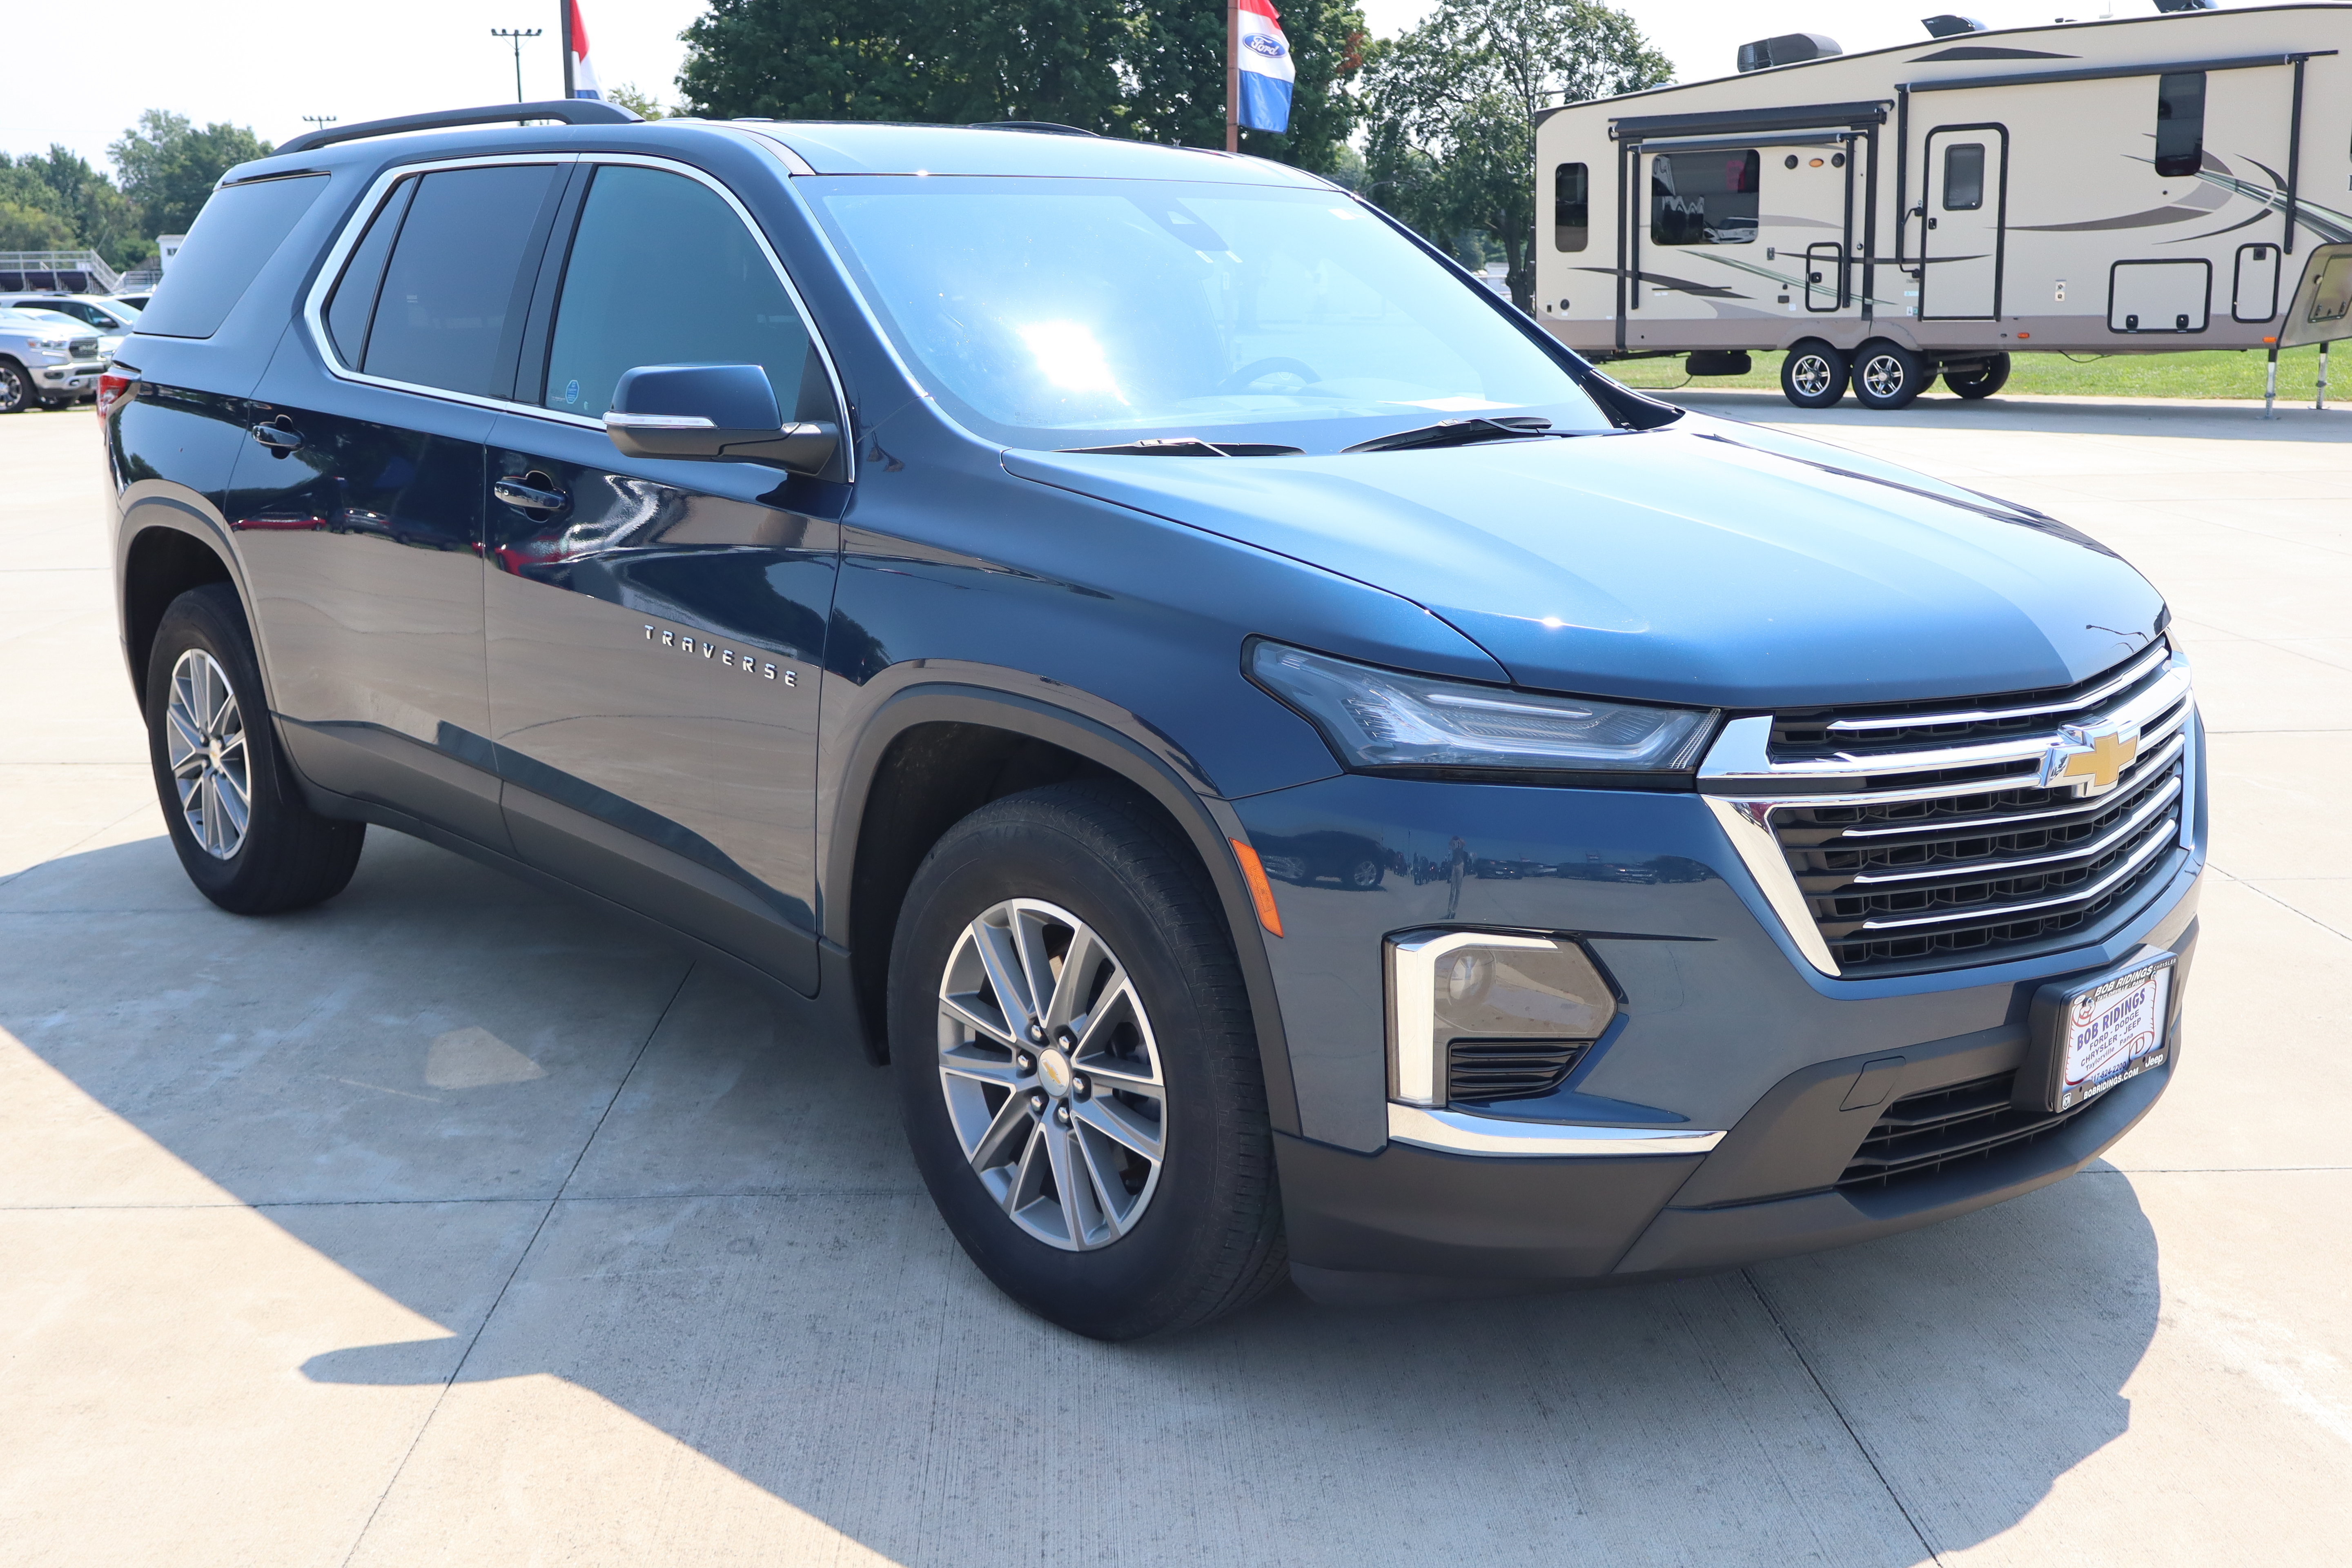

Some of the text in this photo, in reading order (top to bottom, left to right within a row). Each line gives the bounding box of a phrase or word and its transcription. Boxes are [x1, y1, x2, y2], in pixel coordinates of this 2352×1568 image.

[1251, 36, 1279, 55] Ford
[644, 624, 797, 687] TRAVERSE
[2154, 958, 2176, 970] CHRYSLER
[2094, 965, 2153, 997] BOB RIDINGS
[2096, 986, 2127, 1001] TAYLORVILLE
[2132, 978, 2145, 987] PANA
[2077, 988, 2145, 1051] BOB RIDINGS
[2089, 1031, 2108, 1050] FORD
[2115, 1009, 2139, 1032] DODGE
[2081, 1036, 2117, 1067] CHRYSLER
[2124, 1017, 2141, 1035] JEEP
[2085, 1032, 2134, 1071] Taylorville Pana
[2145, 1054, 2163, 1068] Jeep
[2083, 1067, 2139, 1100] BOBRIDINGS.COM
